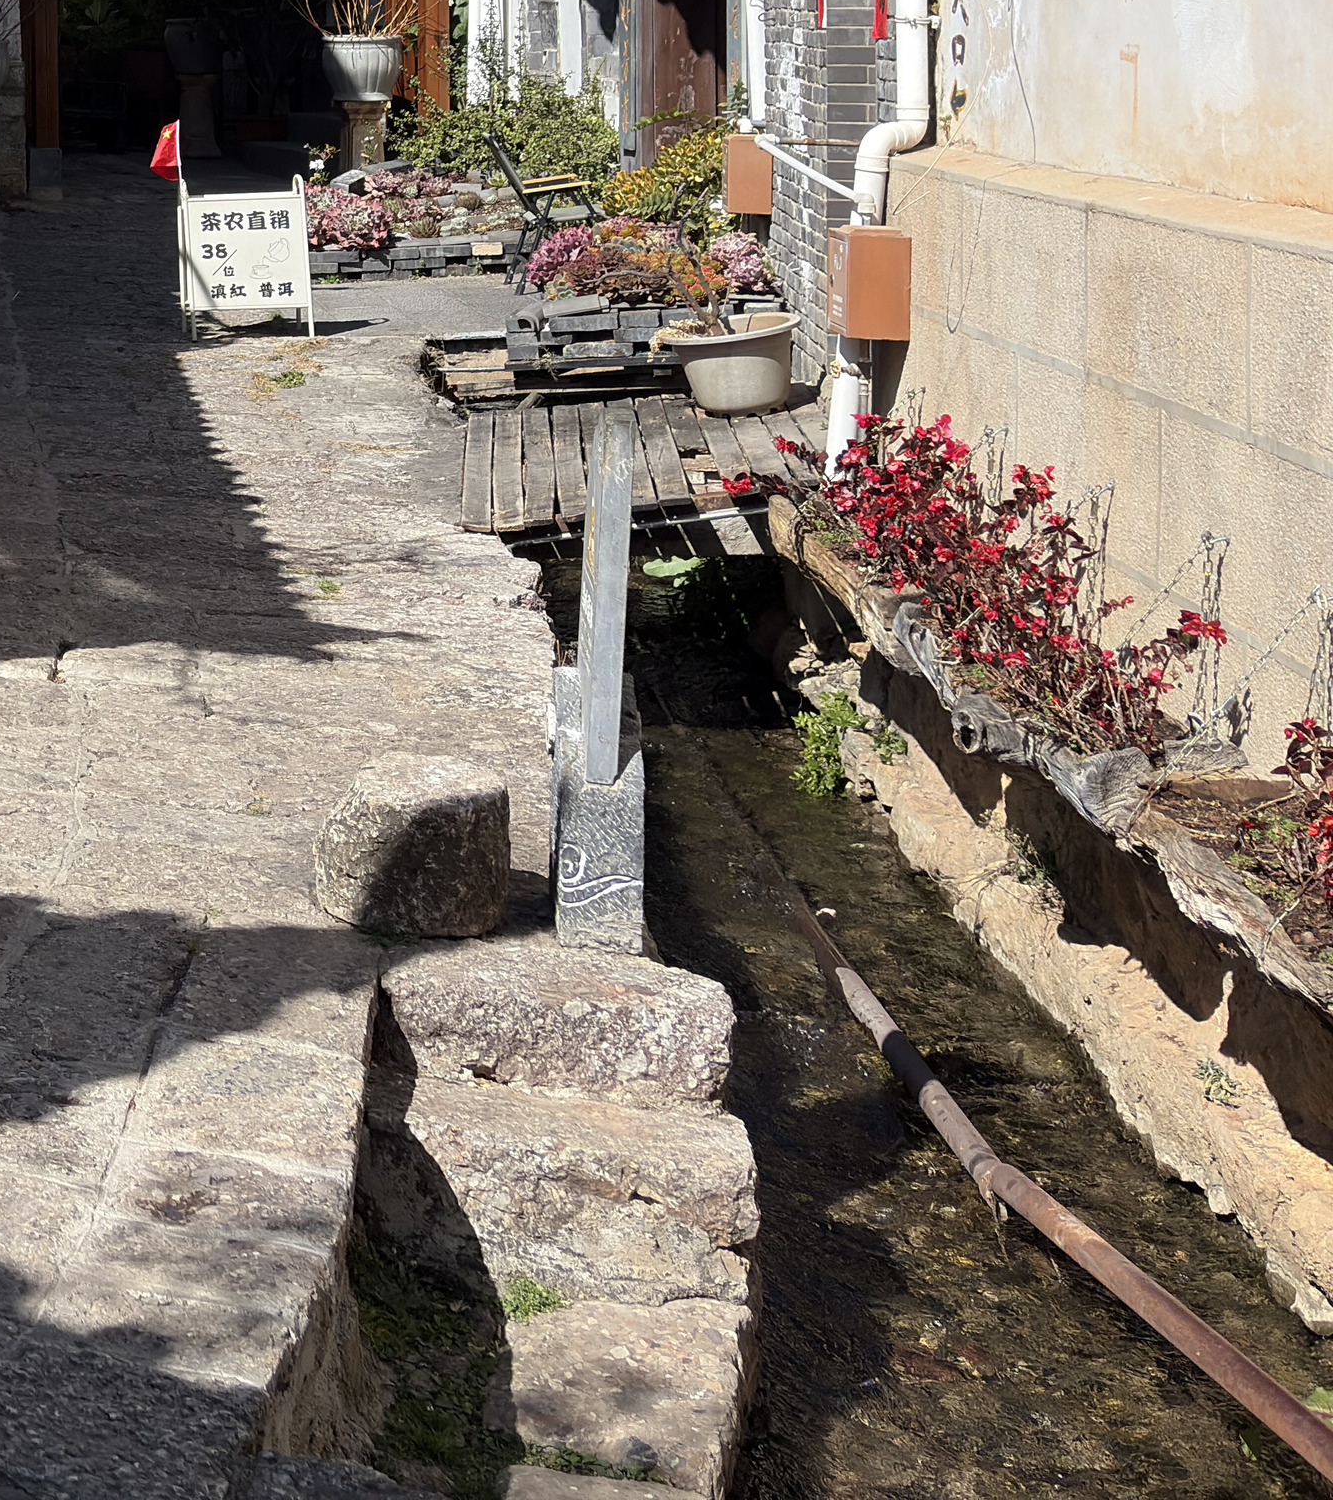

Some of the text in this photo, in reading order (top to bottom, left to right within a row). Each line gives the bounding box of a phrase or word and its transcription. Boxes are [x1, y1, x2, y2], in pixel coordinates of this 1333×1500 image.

[200, 209, 290, 232] 茶农直销
[201, 243, 228, 259] 38
[223, 265, 235, 277] 位
[258, 282, 295, 298] 普洱
